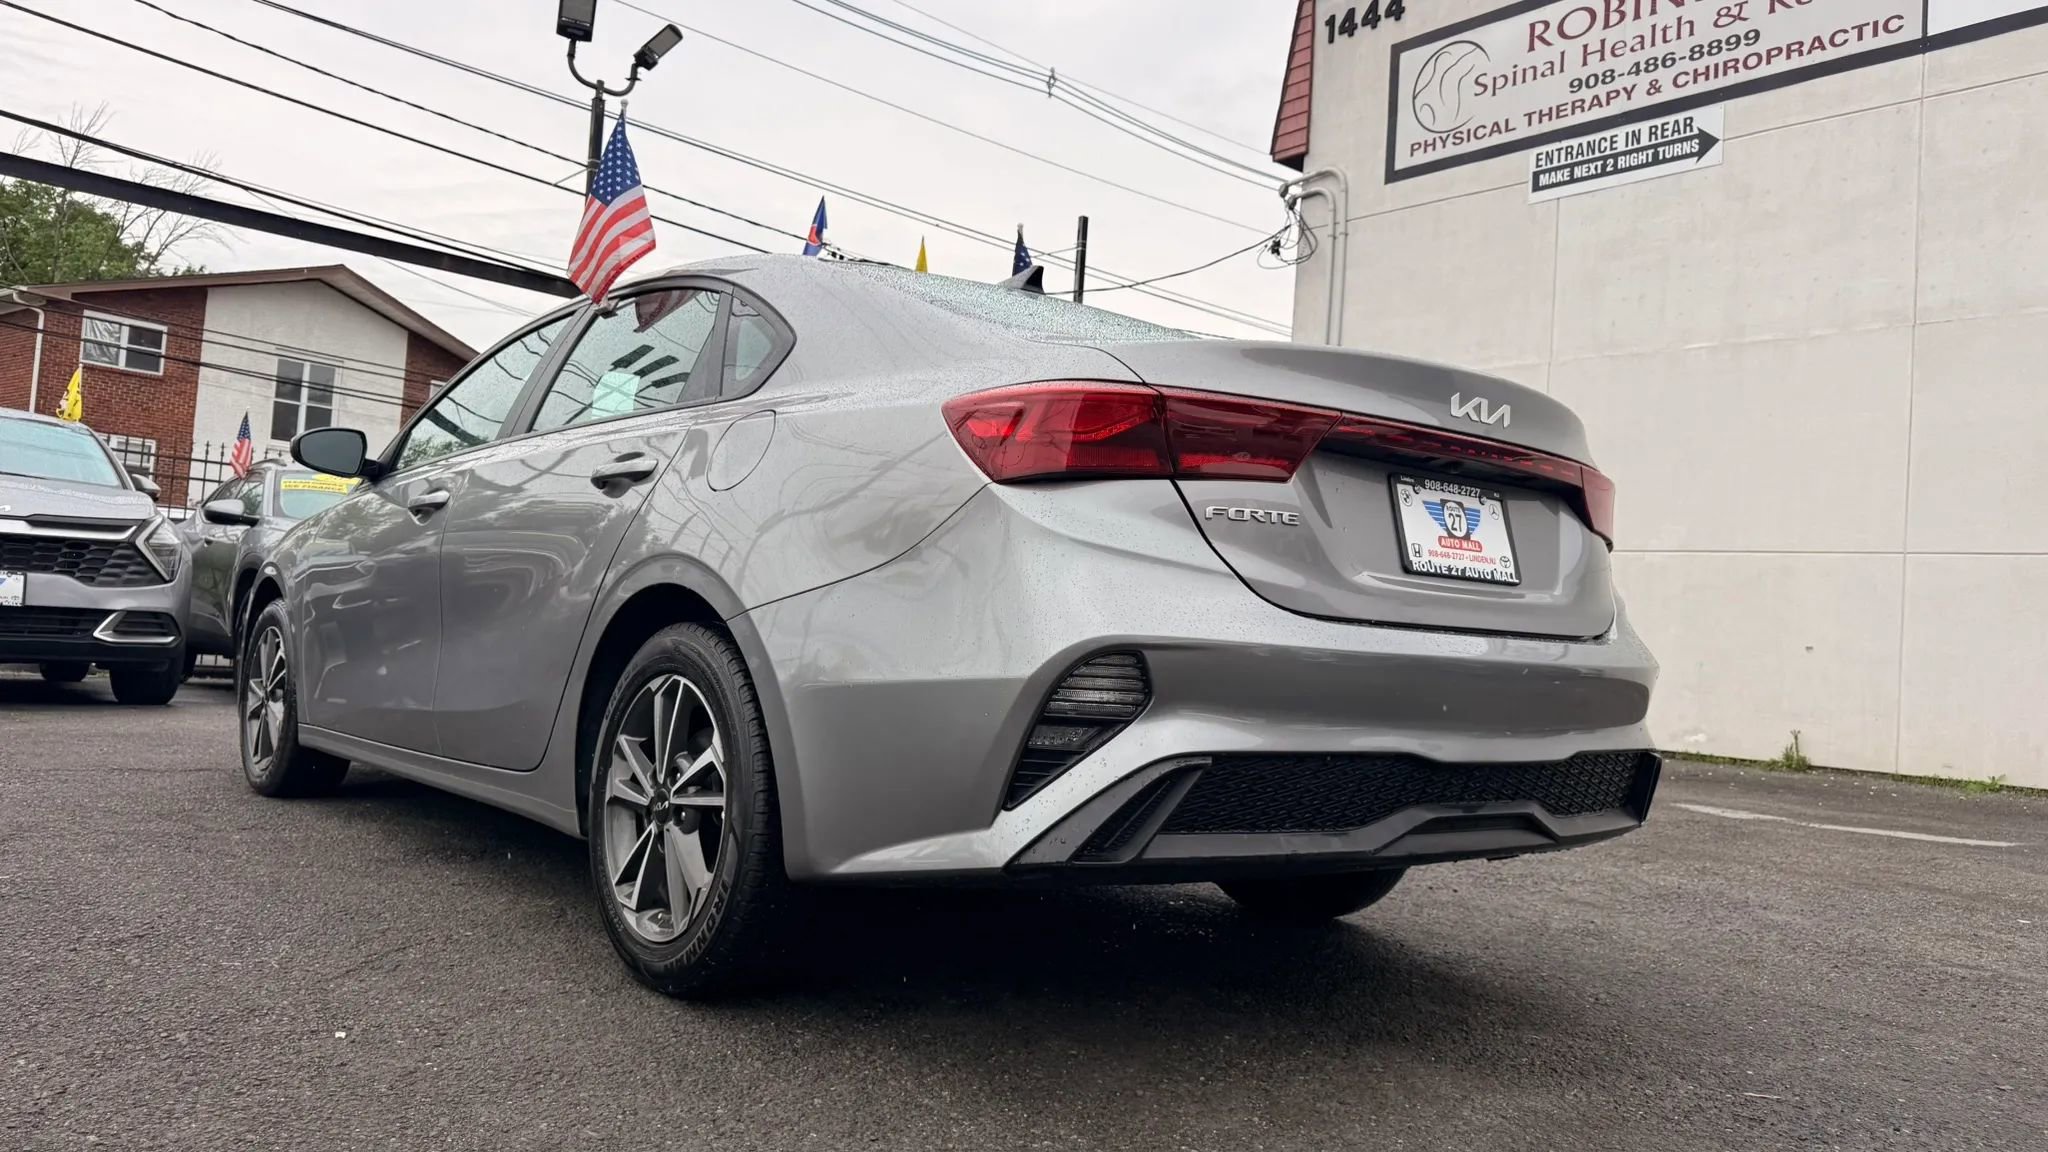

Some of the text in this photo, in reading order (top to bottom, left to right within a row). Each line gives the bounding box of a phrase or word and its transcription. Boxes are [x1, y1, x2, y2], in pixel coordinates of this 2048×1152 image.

[1325, 0, 1405, 44] 1444
[1473, 1, 1750, 97] Spinal Health &
[1569, 29, 1760, 94] 908-486-8899
[1410, 14, 1905, 157] PHYSICAL THERAPY & CHIROPRACTIC
[1535, 116, 1694, 169] ENTRANCE IN REAR
[1539, 139, 1700, 187] MAKE NEXT 2 RIGHT TURNS
[1451, 392, 1511, 428] KIA
[1424, 479, 1480, 498] 908-648-2727
[1205, 506, 1300, 526] FORTE
[1448, 512, 1462, 532] 27
[1441, 537, 1481, 550] AUTO MALL
[1413, 560, 1520, 583] ROUTE 27 AUTO MALL
